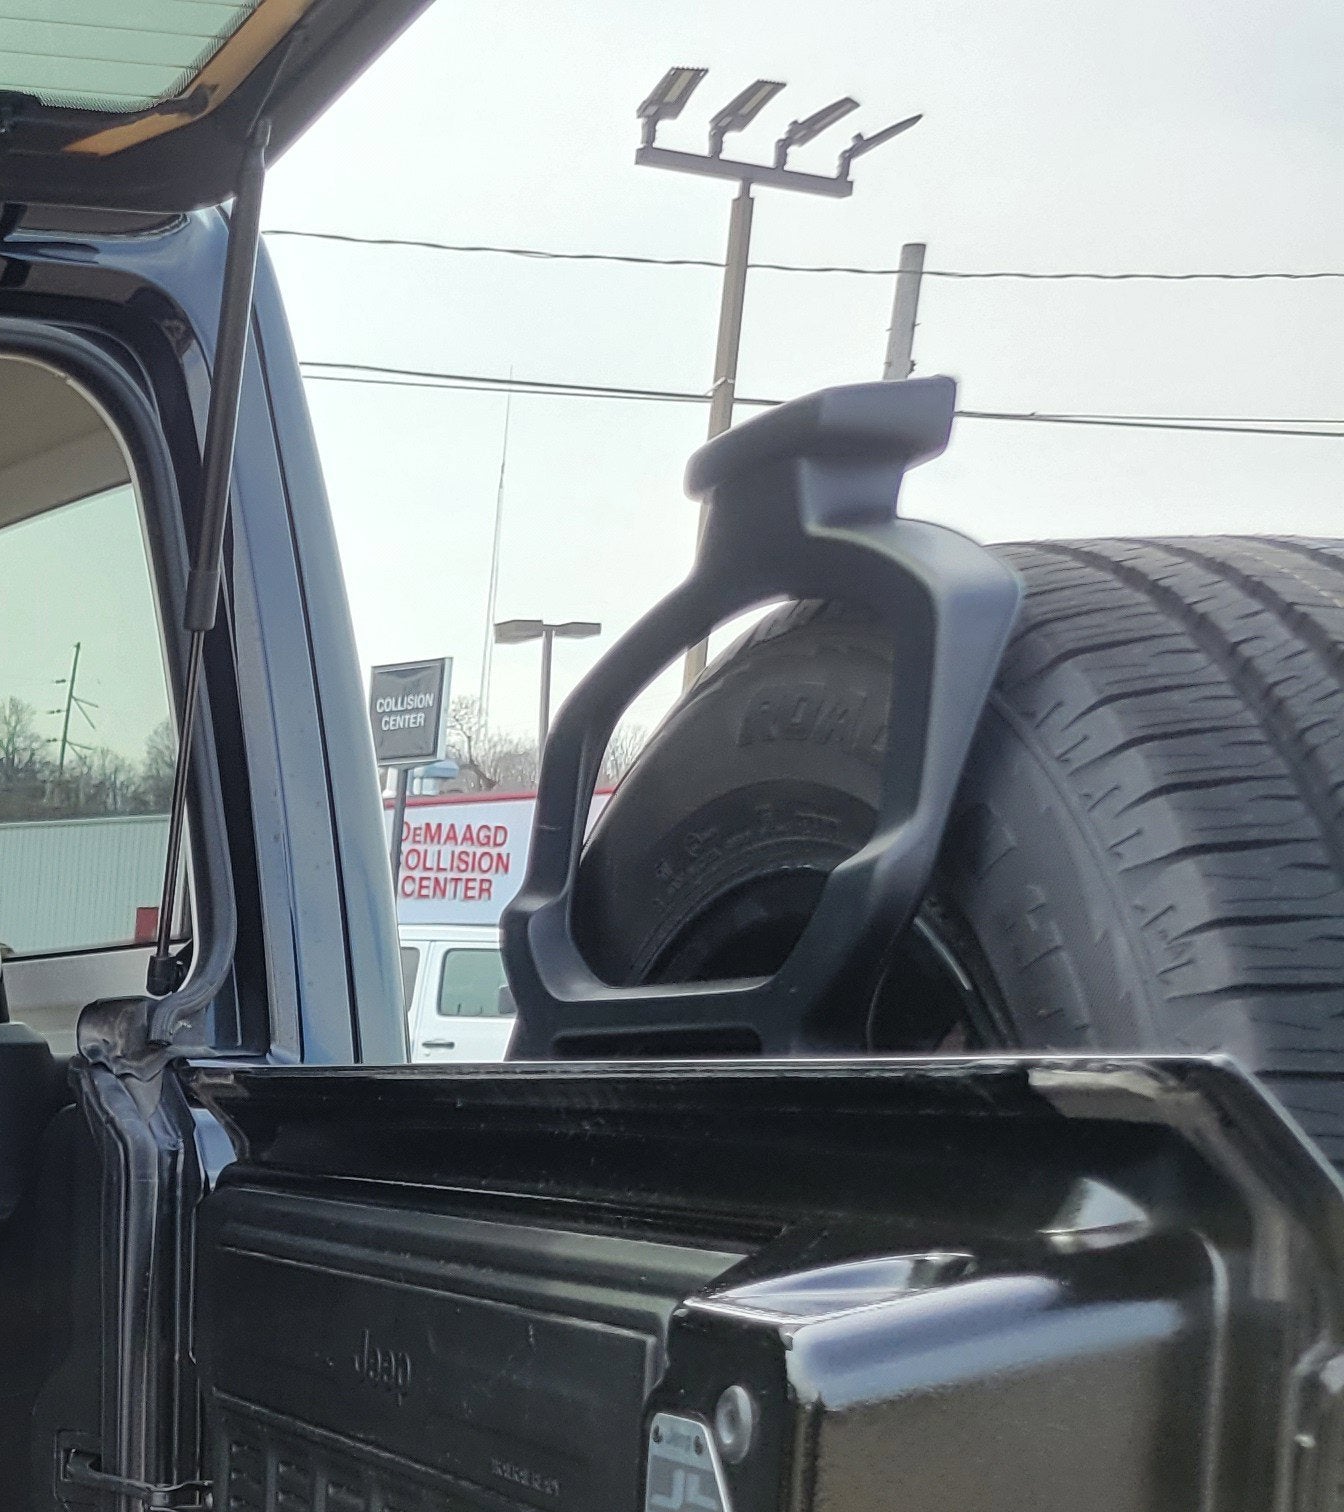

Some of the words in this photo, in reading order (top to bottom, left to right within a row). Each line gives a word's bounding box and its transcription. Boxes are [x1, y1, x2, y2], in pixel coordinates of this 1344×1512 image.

[376, 693, 434, 713] COLLISION
[381, 712, 425, 731] CENTER
[400, 848, 511, 874] OLLISION
[401, 875, 493, 900] CENTER
